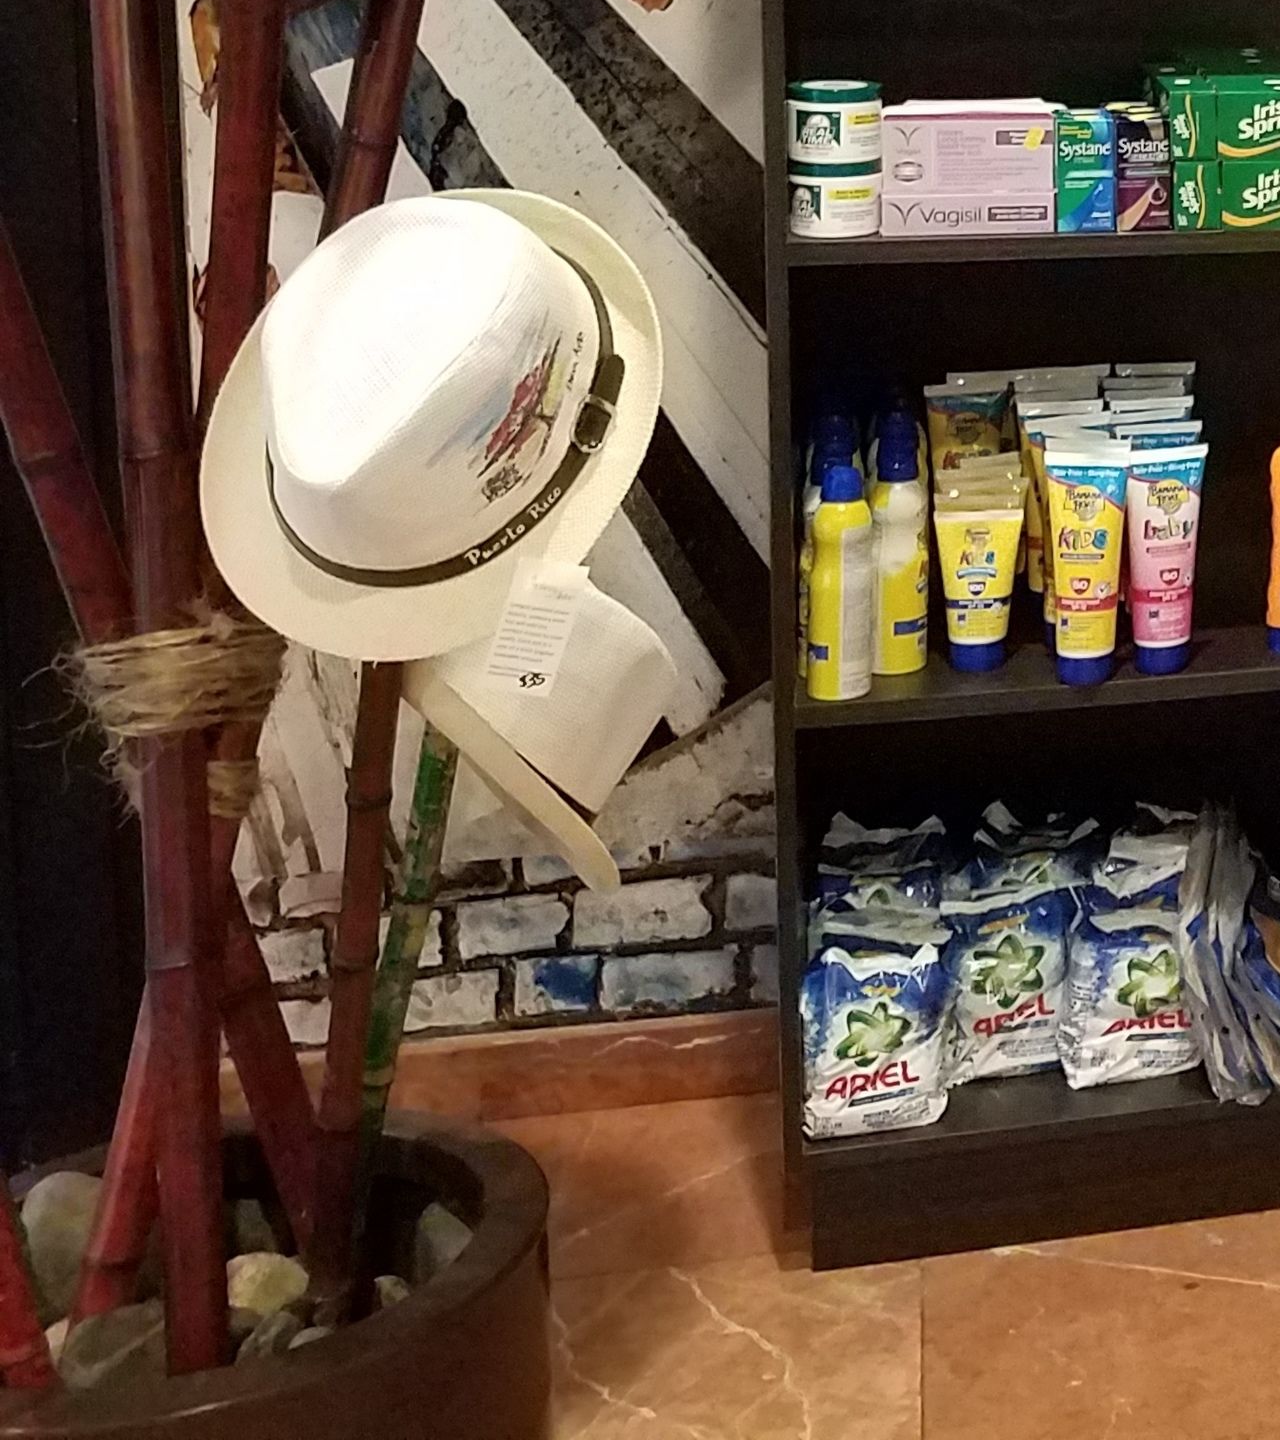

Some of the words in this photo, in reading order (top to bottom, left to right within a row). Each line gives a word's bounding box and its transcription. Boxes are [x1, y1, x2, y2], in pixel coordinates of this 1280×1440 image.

[1059, 141, 1111, 159] Systane
[1118, 137, 1170, 157] Systane
[920, 207, 982, 227] Vagisil
[464, 521, 526, 566] Puerto
[528, 485, 562, 520] Rico
[1144, 515, 1194, 541] baby
[1058, 526, 1109, 551] KIDS
[824, 1060, 920, 1100] ARIEL
